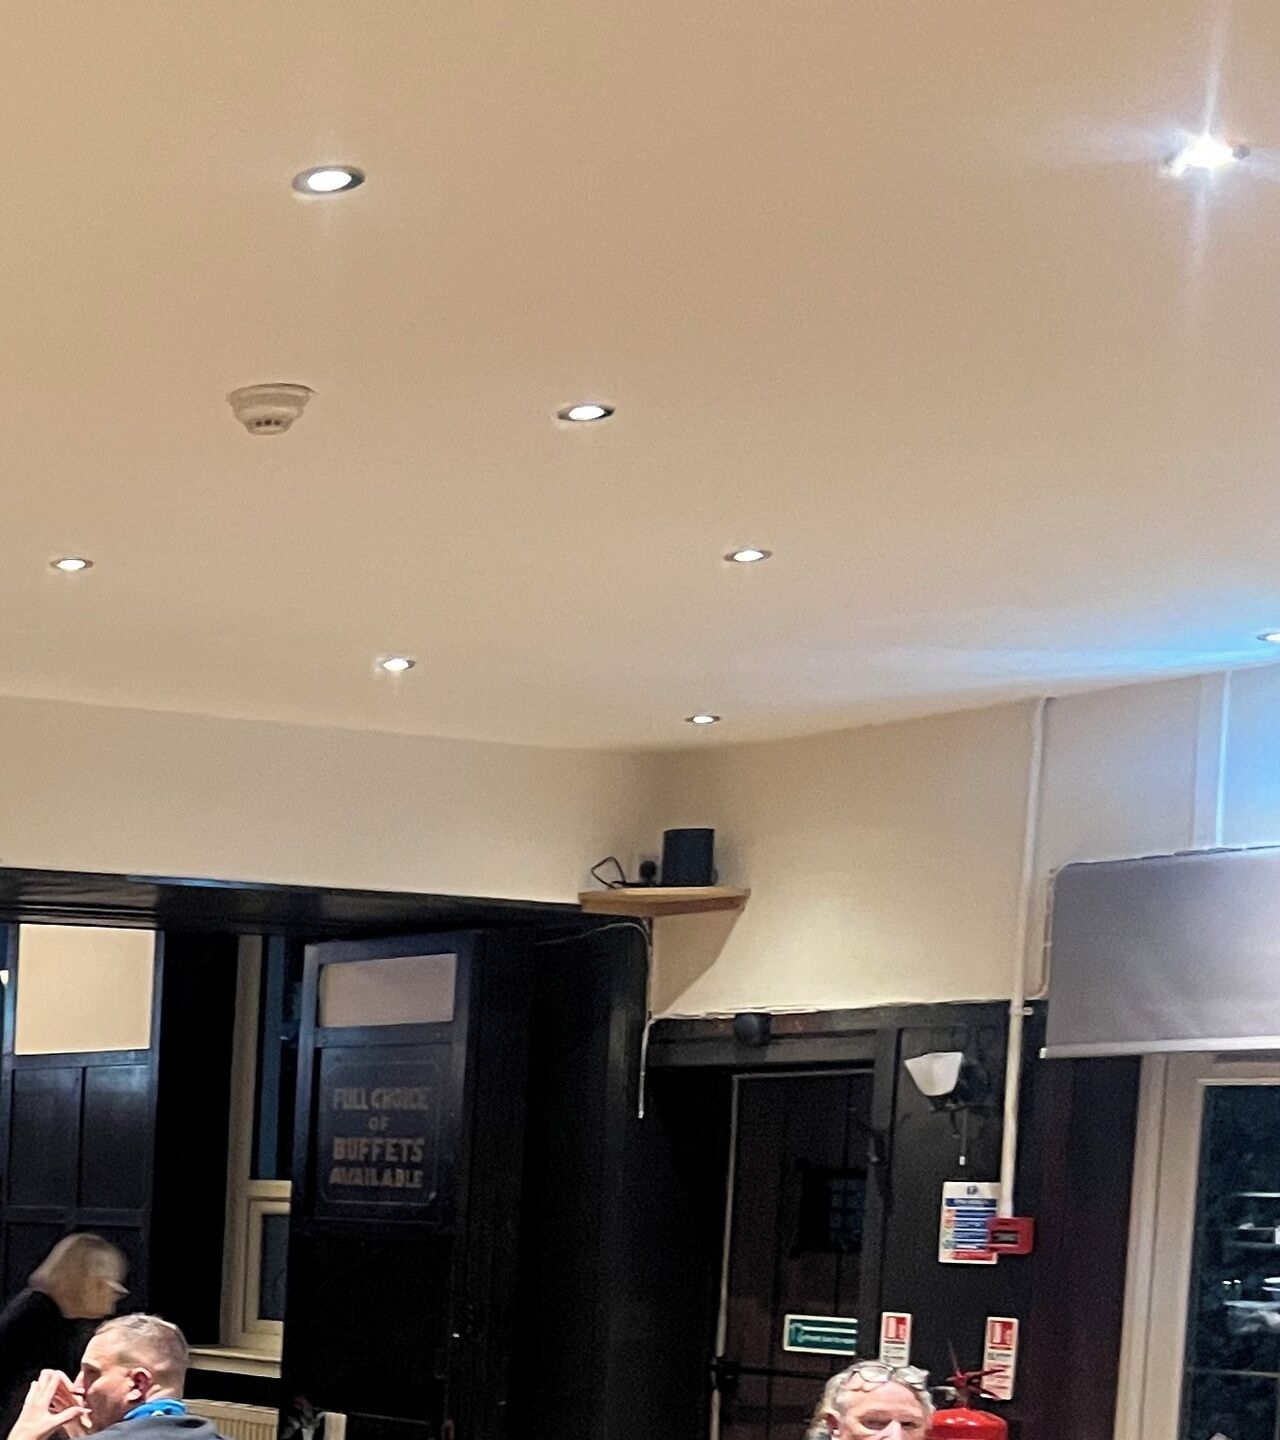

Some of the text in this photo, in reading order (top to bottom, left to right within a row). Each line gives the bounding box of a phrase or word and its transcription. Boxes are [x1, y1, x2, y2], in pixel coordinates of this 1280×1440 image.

[332, 1086, 429, 1110] FULL CHOICE
[368, 1116, 391, 1131] OF
[332, 1136, 425, 1163] BUFFETS
[329, 1166, 424, 1189] AVAILABLE
